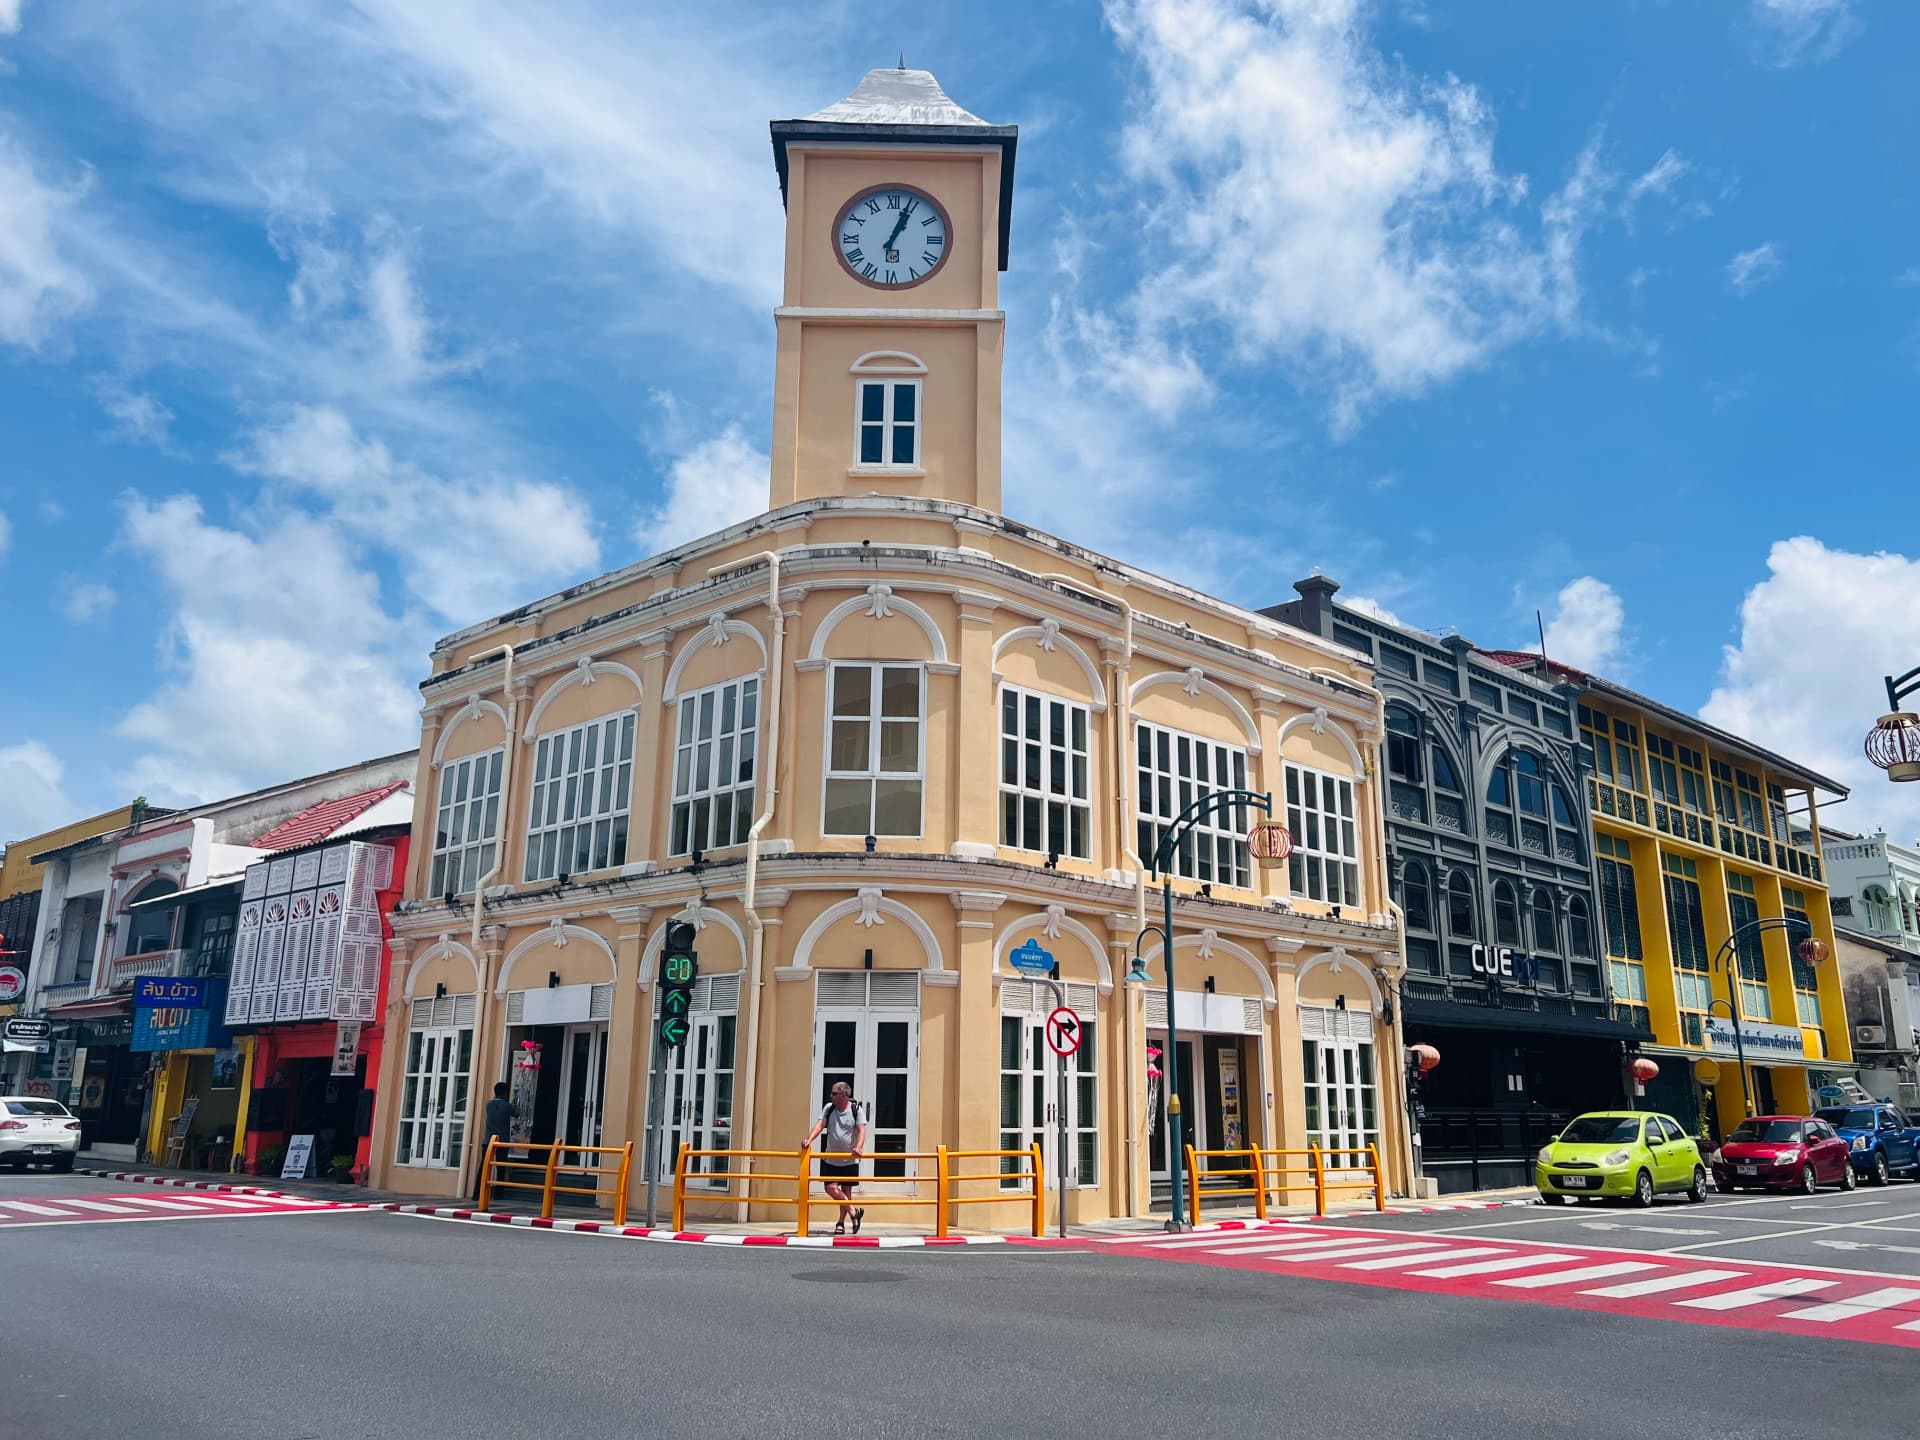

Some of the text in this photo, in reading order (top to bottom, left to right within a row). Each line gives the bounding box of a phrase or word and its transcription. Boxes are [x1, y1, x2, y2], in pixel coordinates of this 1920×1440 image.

[864, 198, 881, 215] XI
[887, 195, 901, 210] XII
[848, 214, 866, 226] X
[921, 216, 937, 227] II
[843, 233, 859, 244] IX
[926, 235, 943, 245] III
[921, 251, 938, 267] IV
[1471, 943, 1512, 976] CUE
[666, 958, 690, 980] 20
